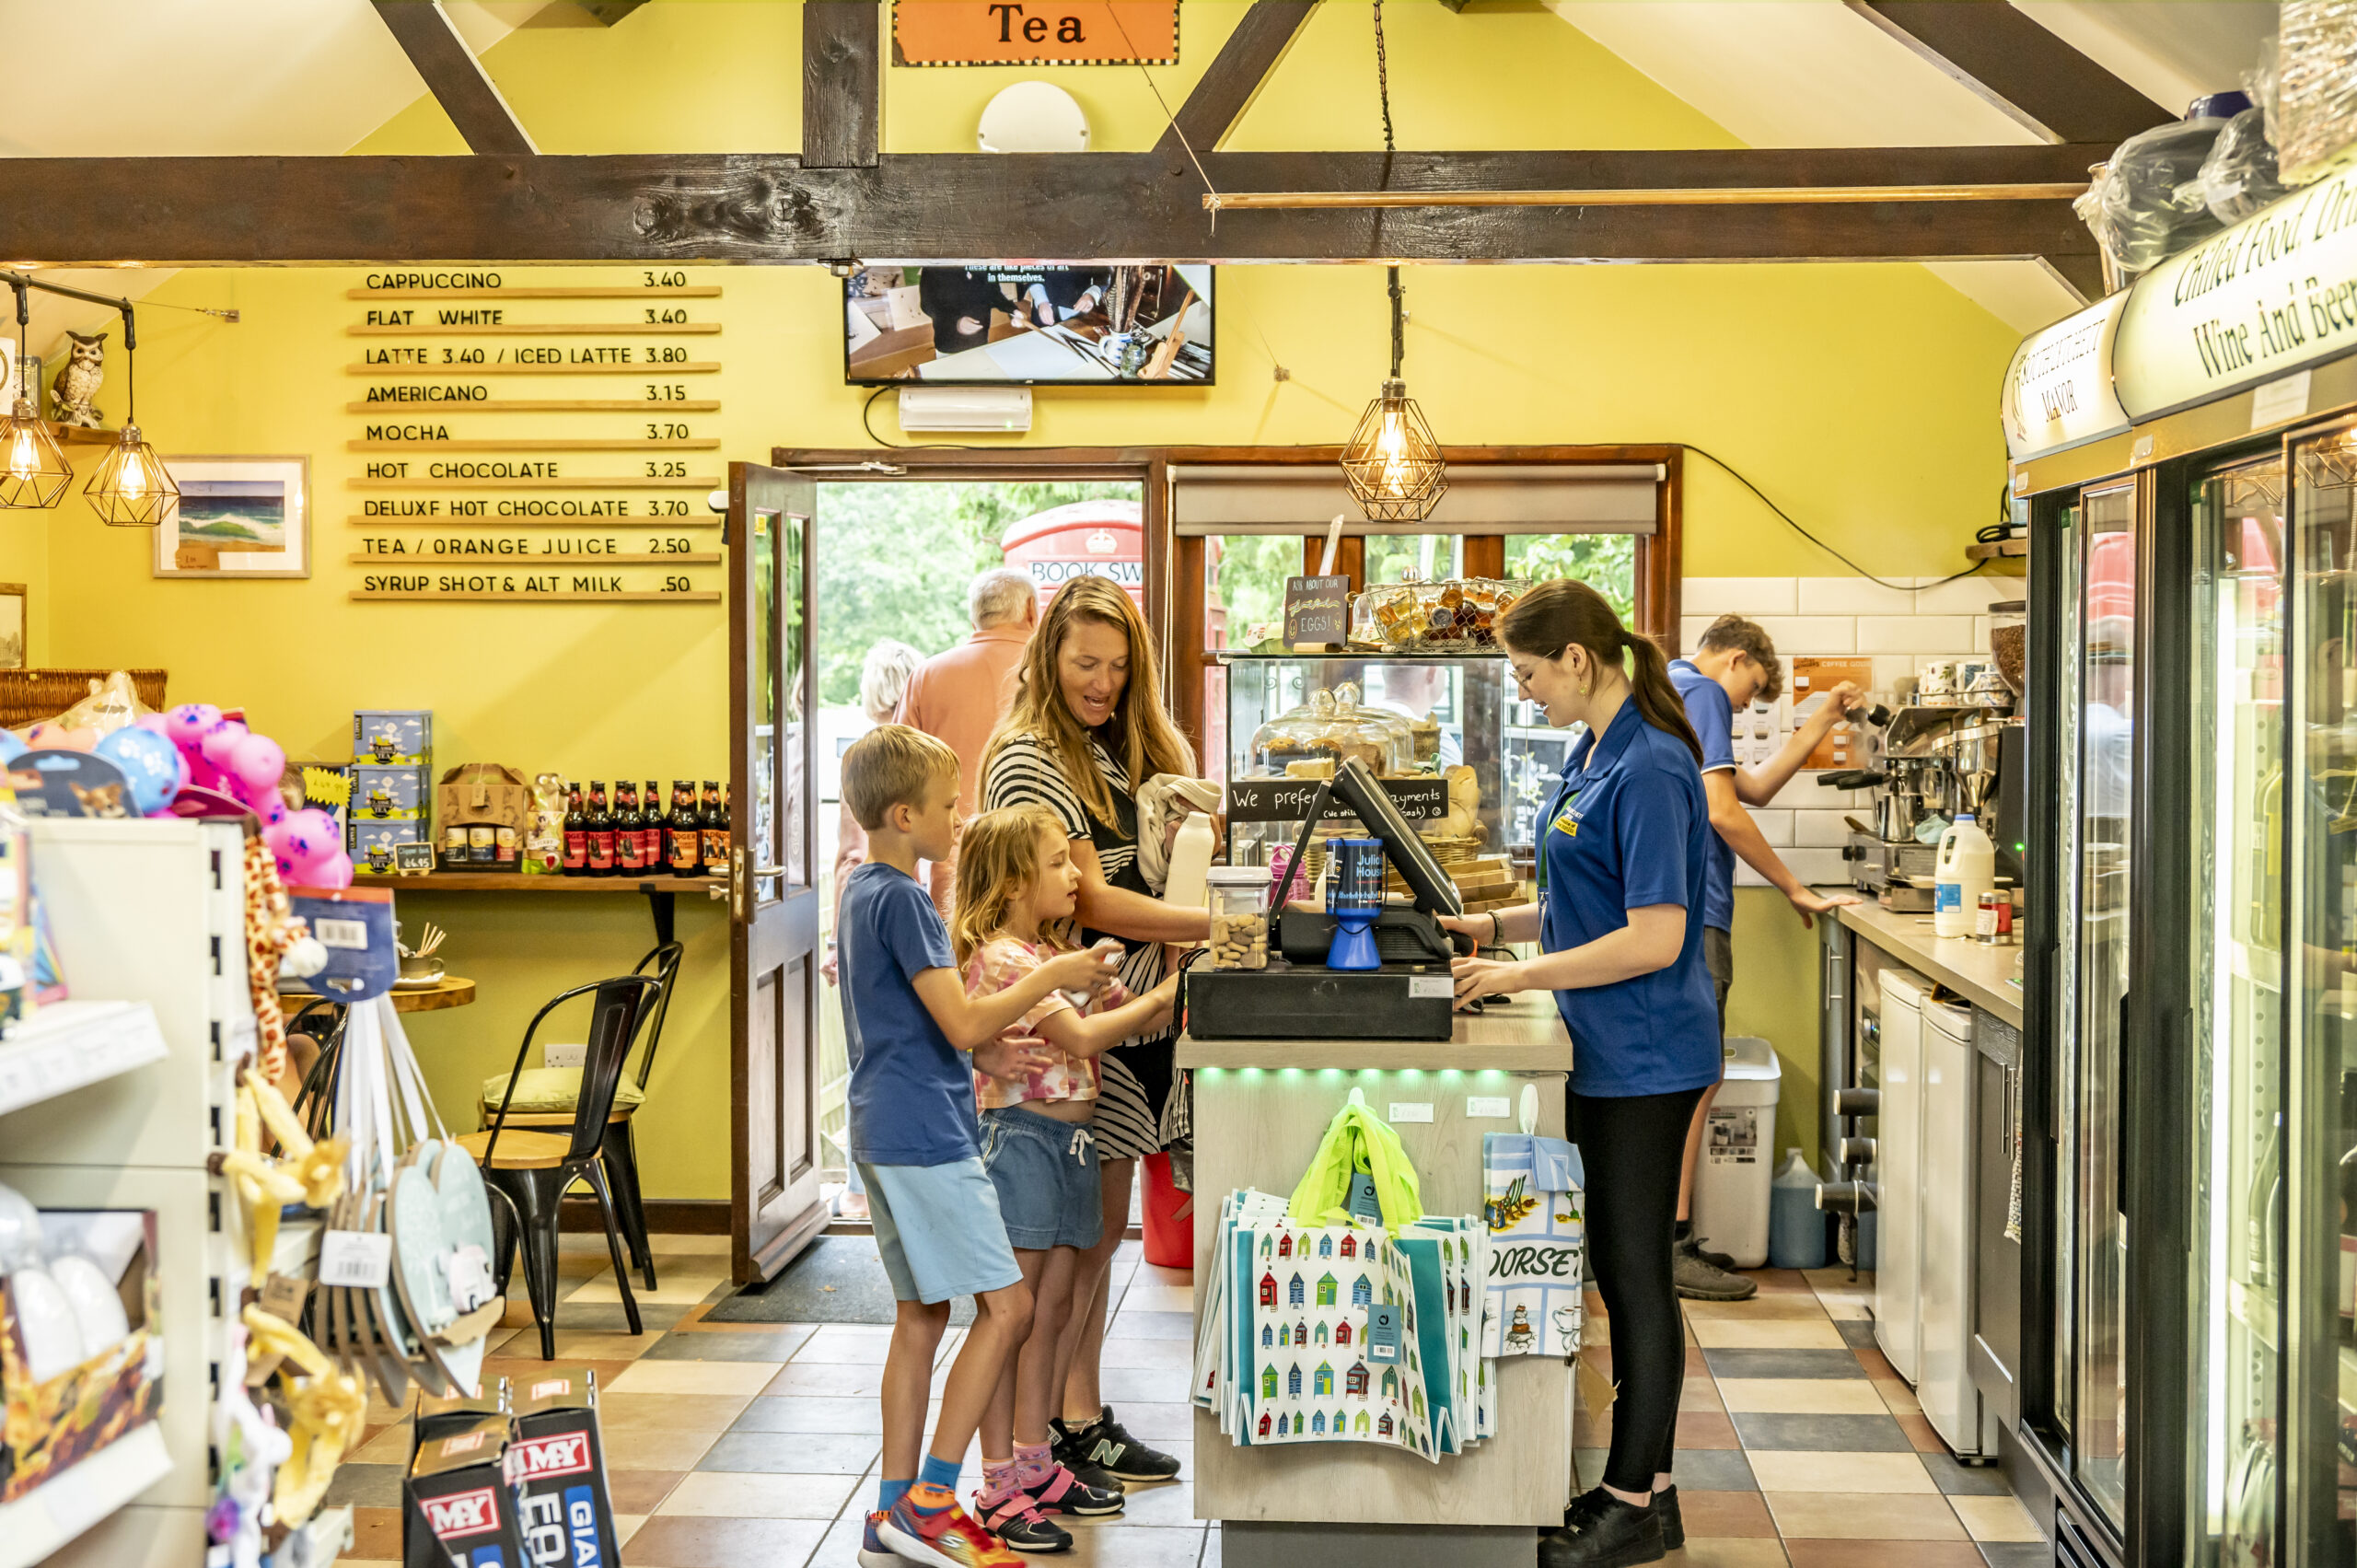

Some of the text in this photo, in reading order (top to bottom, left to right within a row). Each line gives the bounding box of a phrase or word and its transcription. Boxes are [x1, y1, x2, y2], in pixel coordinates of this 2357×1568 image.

[988, 4, 1086, 43] Tea
[2175, 224, 2253, 308] Chilled
[366, 272, 687, 290] CAPPUCCINO 3.40
[987, 273, 1046, 283] in themselves.
[366, 309, 687, 326] FLAT WHITE 3.40
[2193, 318, 2254, 378] Wine
[2257, 281, 2306, 359] And
[366, 349, 428, 364] LATTE
[442, 348, 485, 364] 3.40
[515, 348, 562, 364] ICED
[570, 348, 632, 364] LATTE
[645, 347, 687, 363] 3.80
[366, 385, 686, 402] AMERICANO 3.15
[366, 424, 689, 441] MOCHA 3.70
[366, 462, 687, 479] HOT CHOCOLATE 3.25
[450, 500, 489, 517] HOT
[497, 500, 628, 517] CHOCOLATE
[648, 500, 689, 517] 3.70
[363, 538, 405, 554] TEA
[434, 538, 529, 554] ORANGE
[542, 538, 617, 554] JUICE
[649, 538, 691, 553] 2.50
[1032, 562, 1097, 581] BOOK
[365, 575, 691, 592] SYRUP SHOT & ALT MILK .50
[1306, 579, 1324, 590] ABOUT
[1325, 579, 1339, 589] OUR
[1301, 615, 1331, 633] EGGS!
[1233, 789, 1259, 807] We
[1387, 788, 1441, 810] ayments
[1087, 1438, 1127, 1467] N
[569, 1500, 600, 1568] GIA
